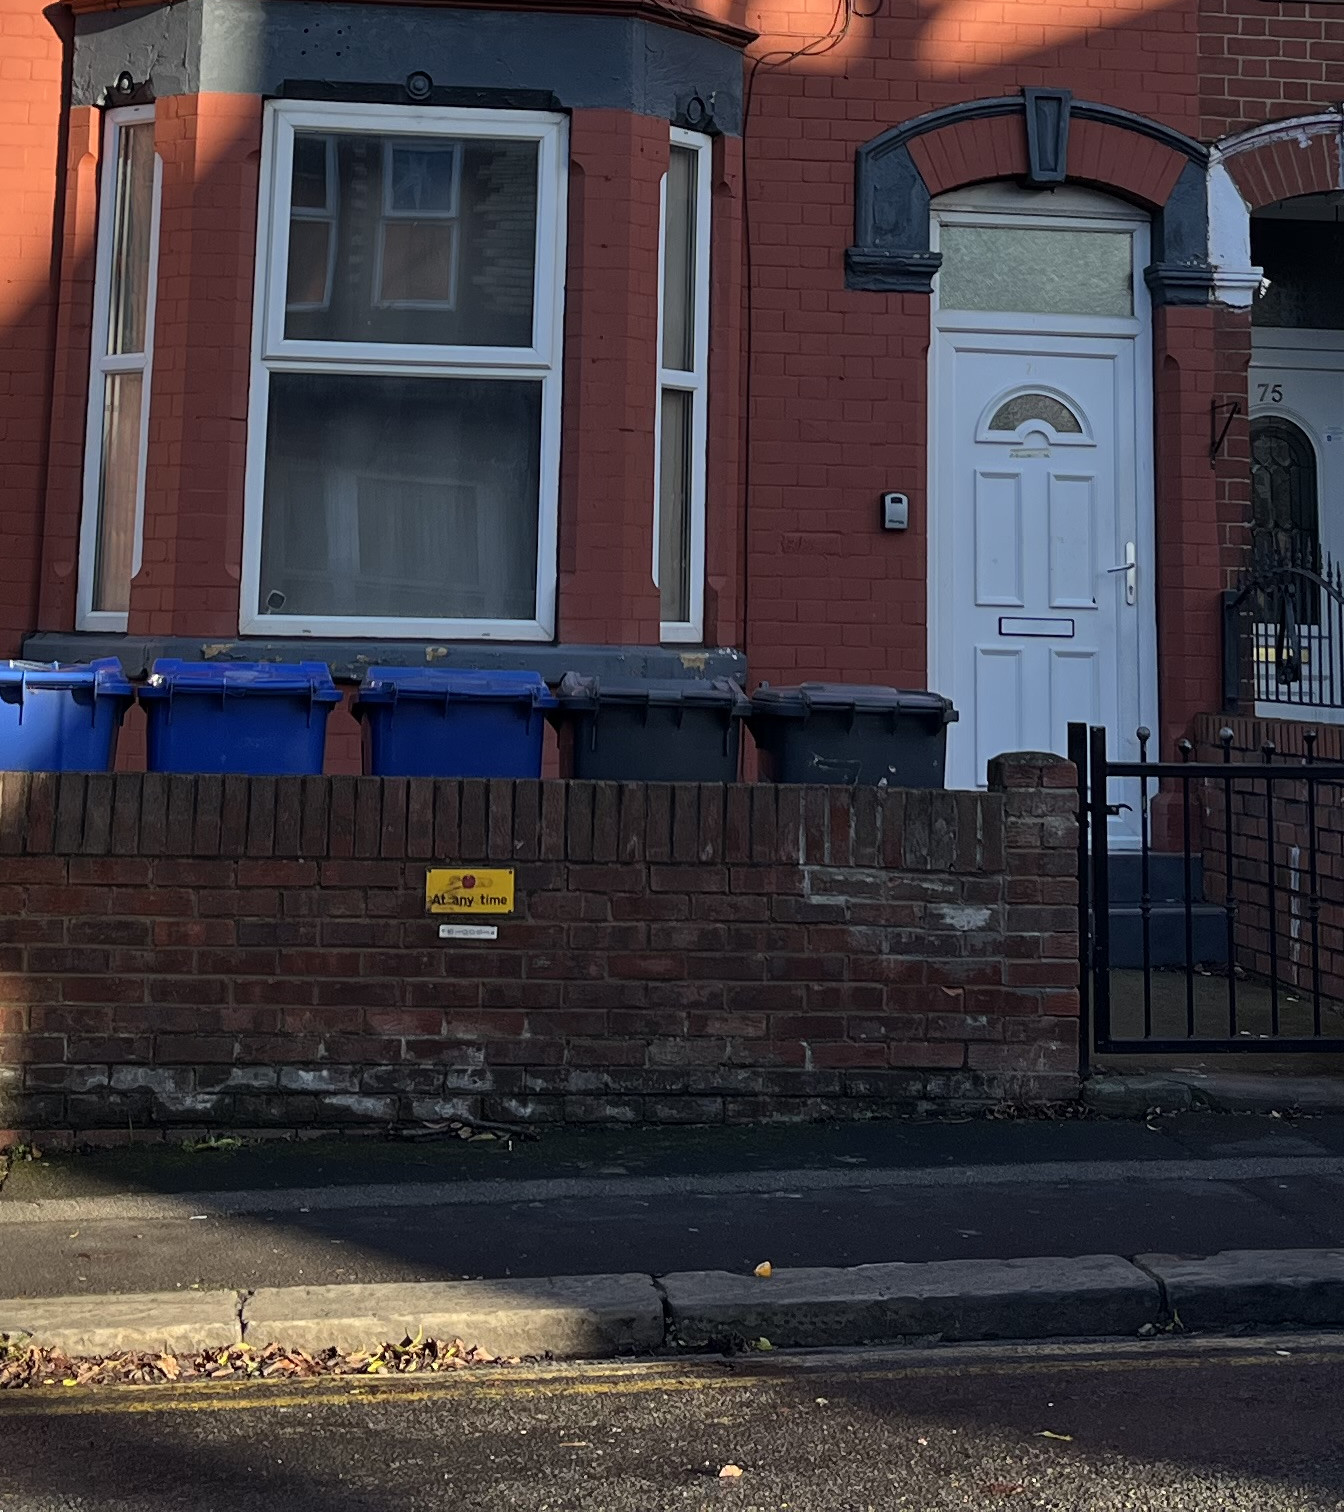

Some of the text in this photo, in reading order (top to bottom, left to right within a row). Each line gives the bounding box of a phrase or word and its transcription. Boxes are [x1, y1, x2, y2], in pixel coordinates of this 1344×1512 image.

[1257, 384, 1284, 403] 75
[432, 894, 508, 907] At any time
